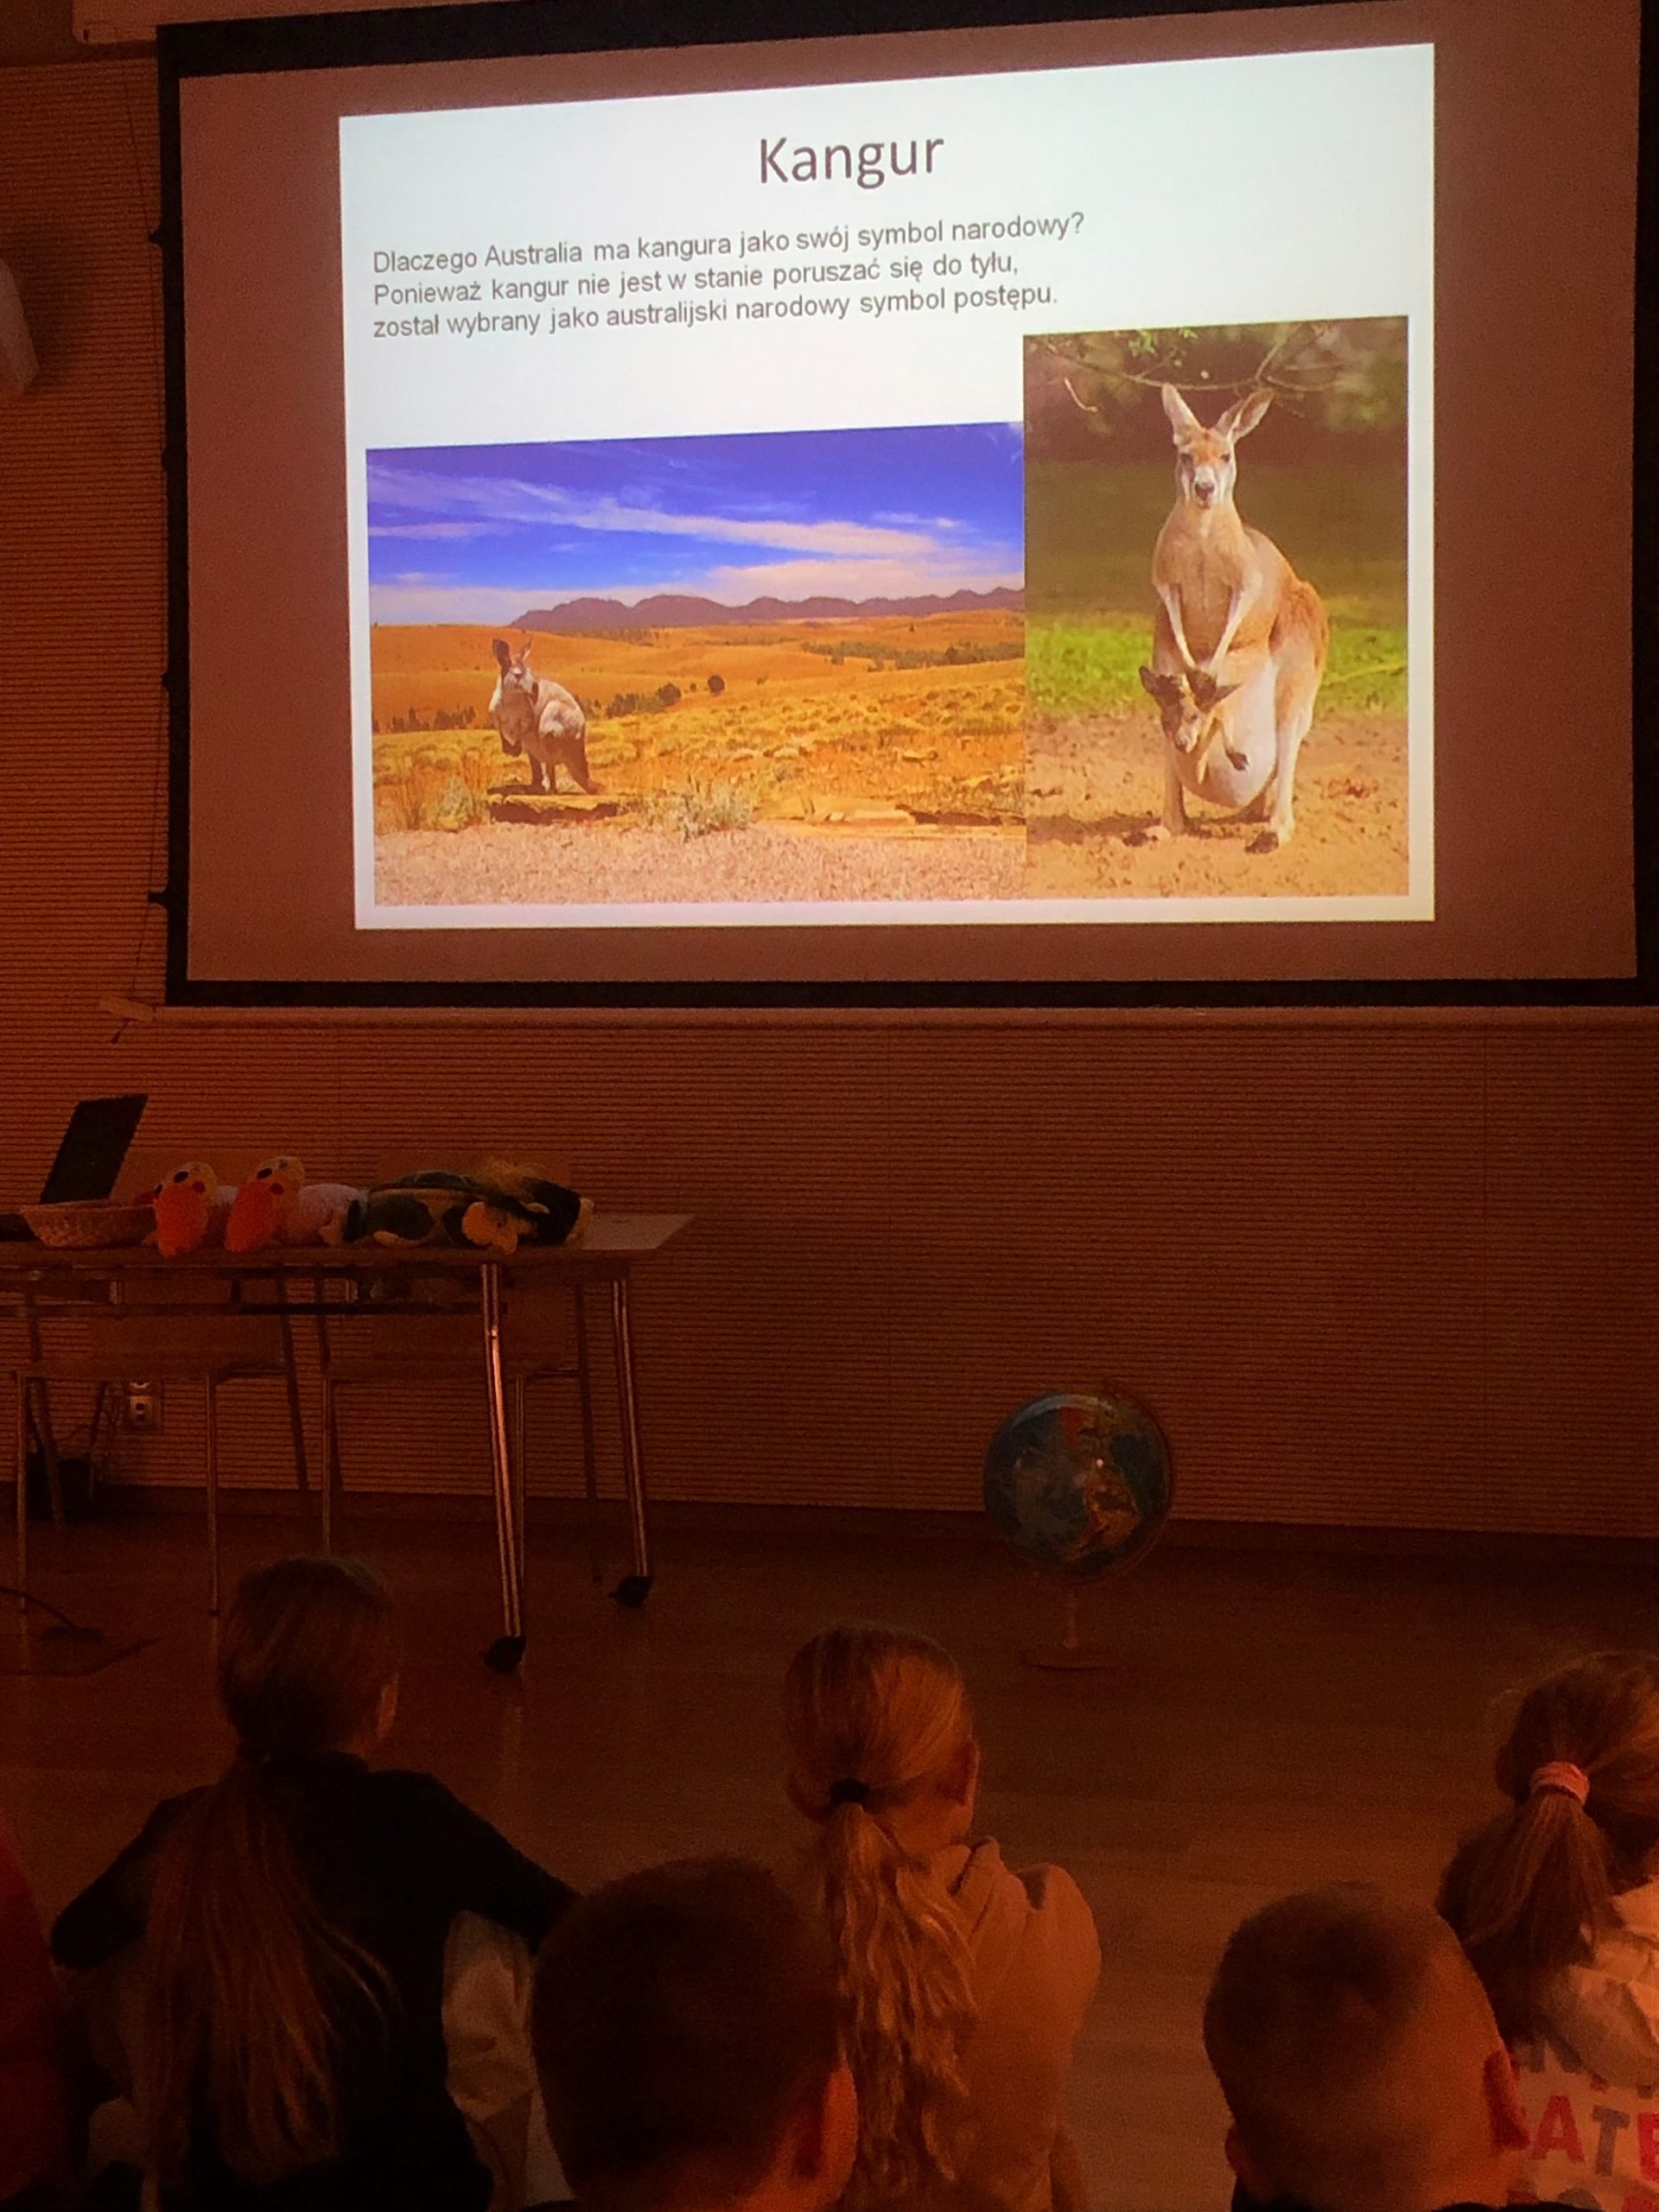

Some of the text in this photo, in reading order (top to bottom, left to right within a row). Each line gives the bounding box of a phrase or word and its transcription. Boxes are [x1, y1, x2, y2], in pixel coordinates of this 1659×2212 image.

[760, 137, 945, 190] Kangur
[373, 211, 1085, 274] Dlaczego Australia ma kangura jako swój symbol narodowy?
[373, 251, 1019, 306] Ponieważ kangur nie jest w stanie poruszać się do tyłu,
[372, 283, 1058, 340] został wybrany jako australijski narodowy symbol postępu.
